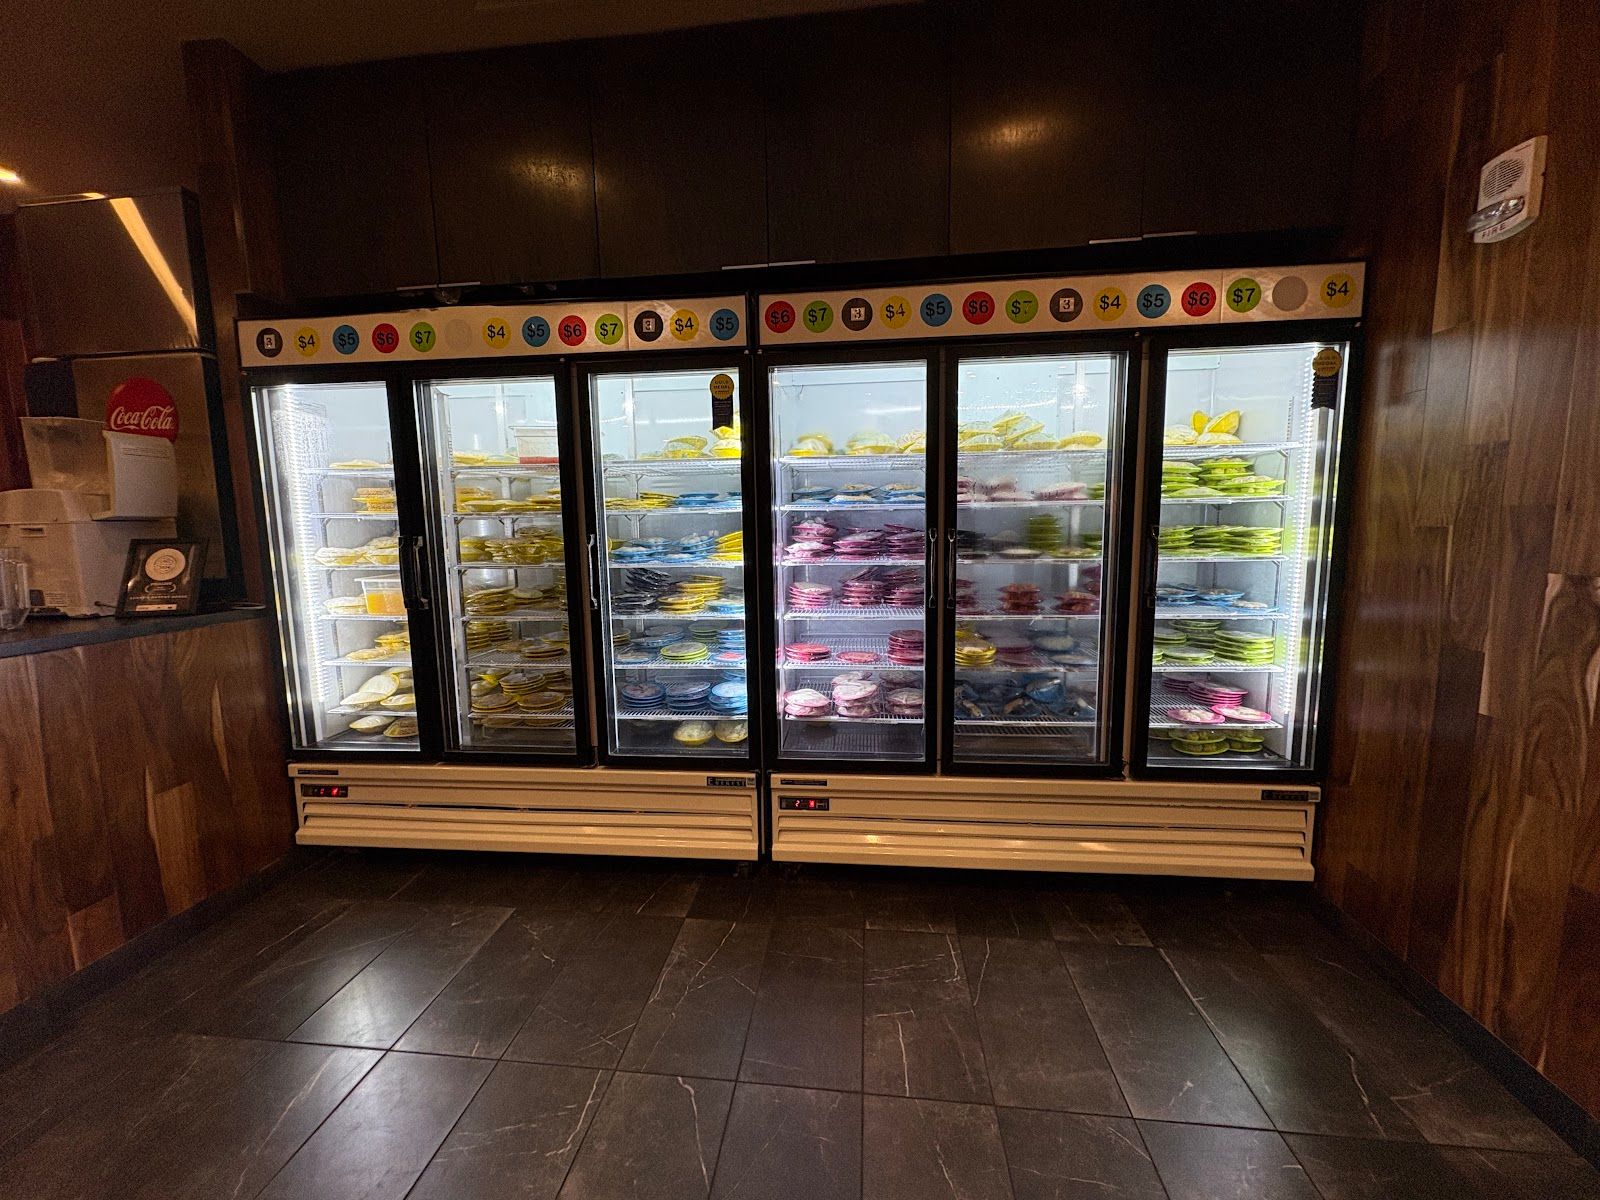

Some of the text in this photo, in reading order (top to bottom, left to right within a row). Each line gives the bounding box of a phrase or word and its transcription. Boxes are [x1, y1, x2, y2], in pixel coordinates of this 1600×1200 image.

[1482, 223, 1507, 239] FIRE
[771, 310, 789, 325] $6
[809, 308, 827, 325] $7
[886, 304, 905, 321] $4
[926, 301, 945, 319] $5
[969, 300, 988, 315] $6
[1011, 300, 1032, 317] $7
[1062, 299, 1071, 310] 3
[1100, 295, 1121, 312] $4
[1143, 293, 1163, 310] $5
[1188, 291, 1209, 307] $6
[1233, 288, 1254, 305] $7
[1327, 280, 1349, 298] $4
[298, 335, 315, 350] $4
[338, 332, 355, 349] $5
[376, 332, 394, 347] $6
[415, 330, 431, 346] $7
[488, 325, 505, 341] $4
[528, 323, 544, 340] $5
[564, 324, 581, 340] $6
[600, 323, 617, 339] $7
[675, 317, 694, 334] $4
[716, 317, 734, 332] $5
[110, 405, 175, 431] Coca-Cola
